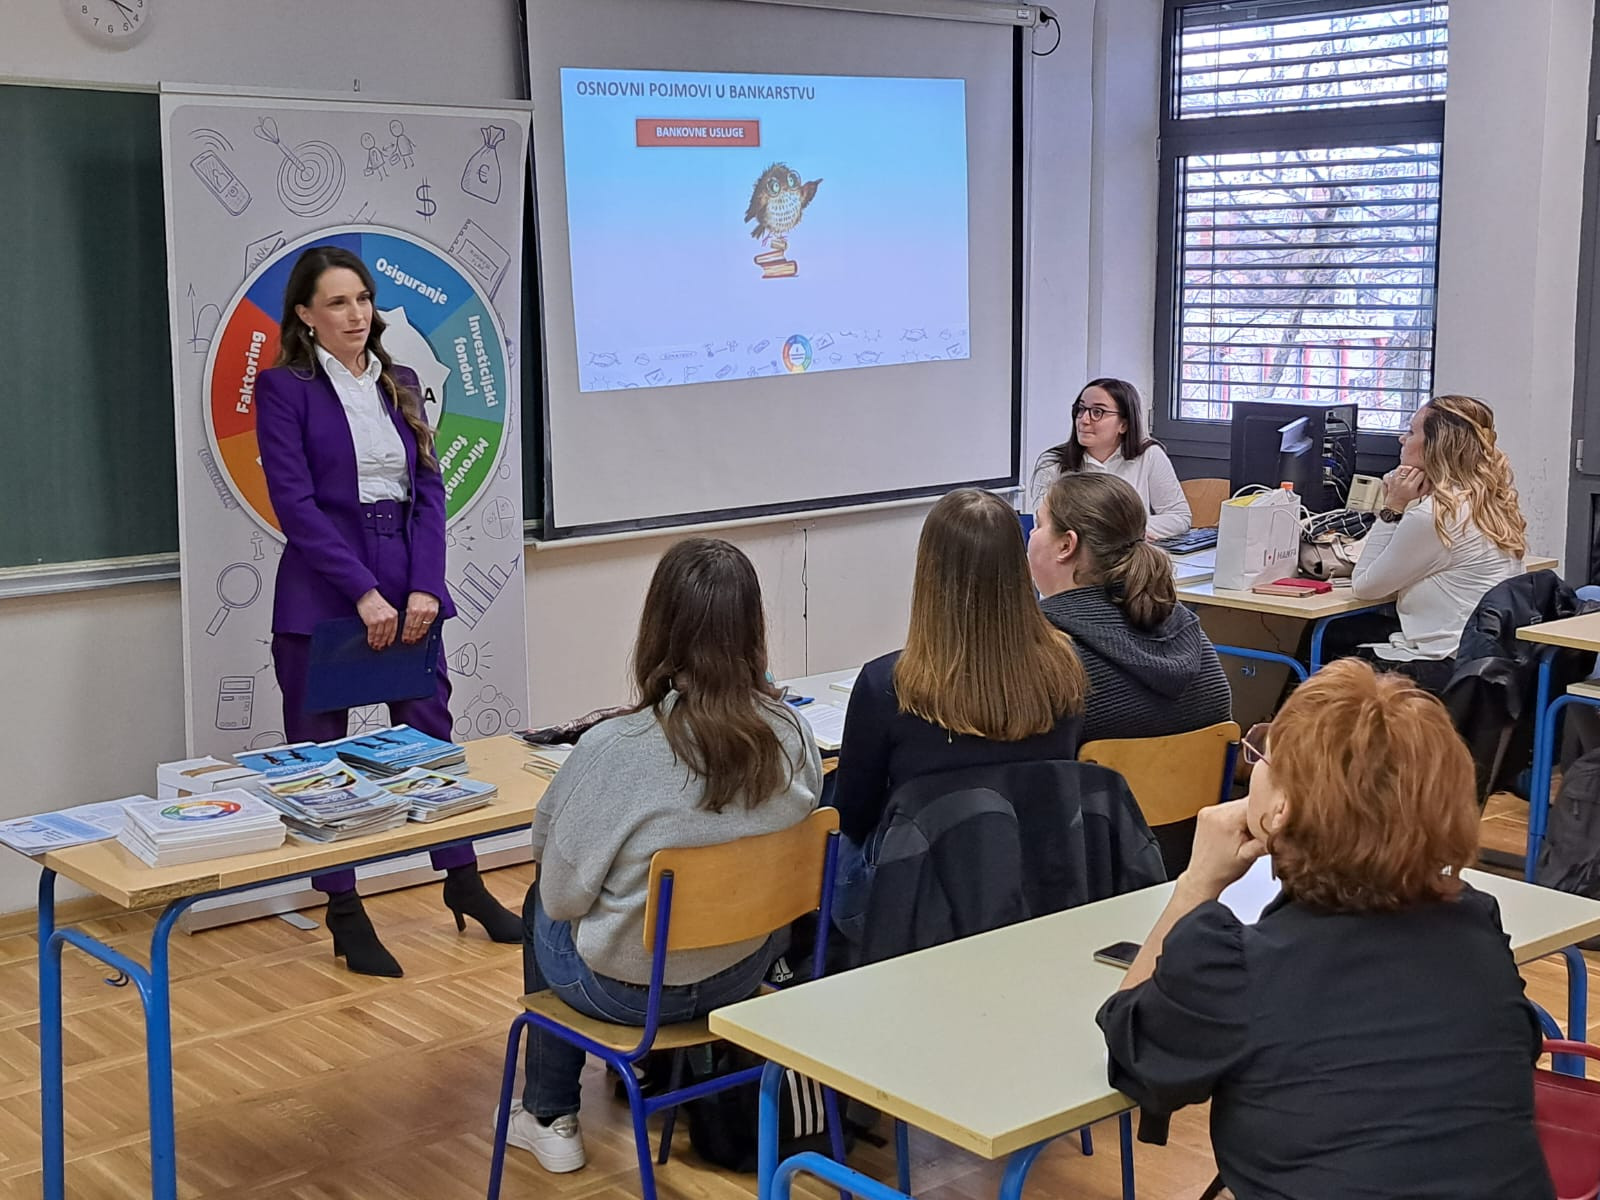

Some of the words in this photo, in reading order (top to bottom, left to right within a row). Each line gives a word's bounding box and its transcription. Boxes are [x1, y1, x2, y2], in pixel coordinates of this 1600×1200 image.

[108, 25, 114, 33] 6
[576, 80, 645, 97] OSNOVNI
[649, 82, 712, 98] POJMOVI
[715, 84, 726, 99] U
[729, 84, 816, 101] BANKARSTVU
[656, 126, 707, 138] BANKOVNE
[709, 127, 744, 138] USLUGE
[375, 257, 448, 305] Osiguranje
[235, 330, 267, 414] Faktoring
[453, 336, 479, 397] fondovi
[468, 314, 499, 408] Investicijski
